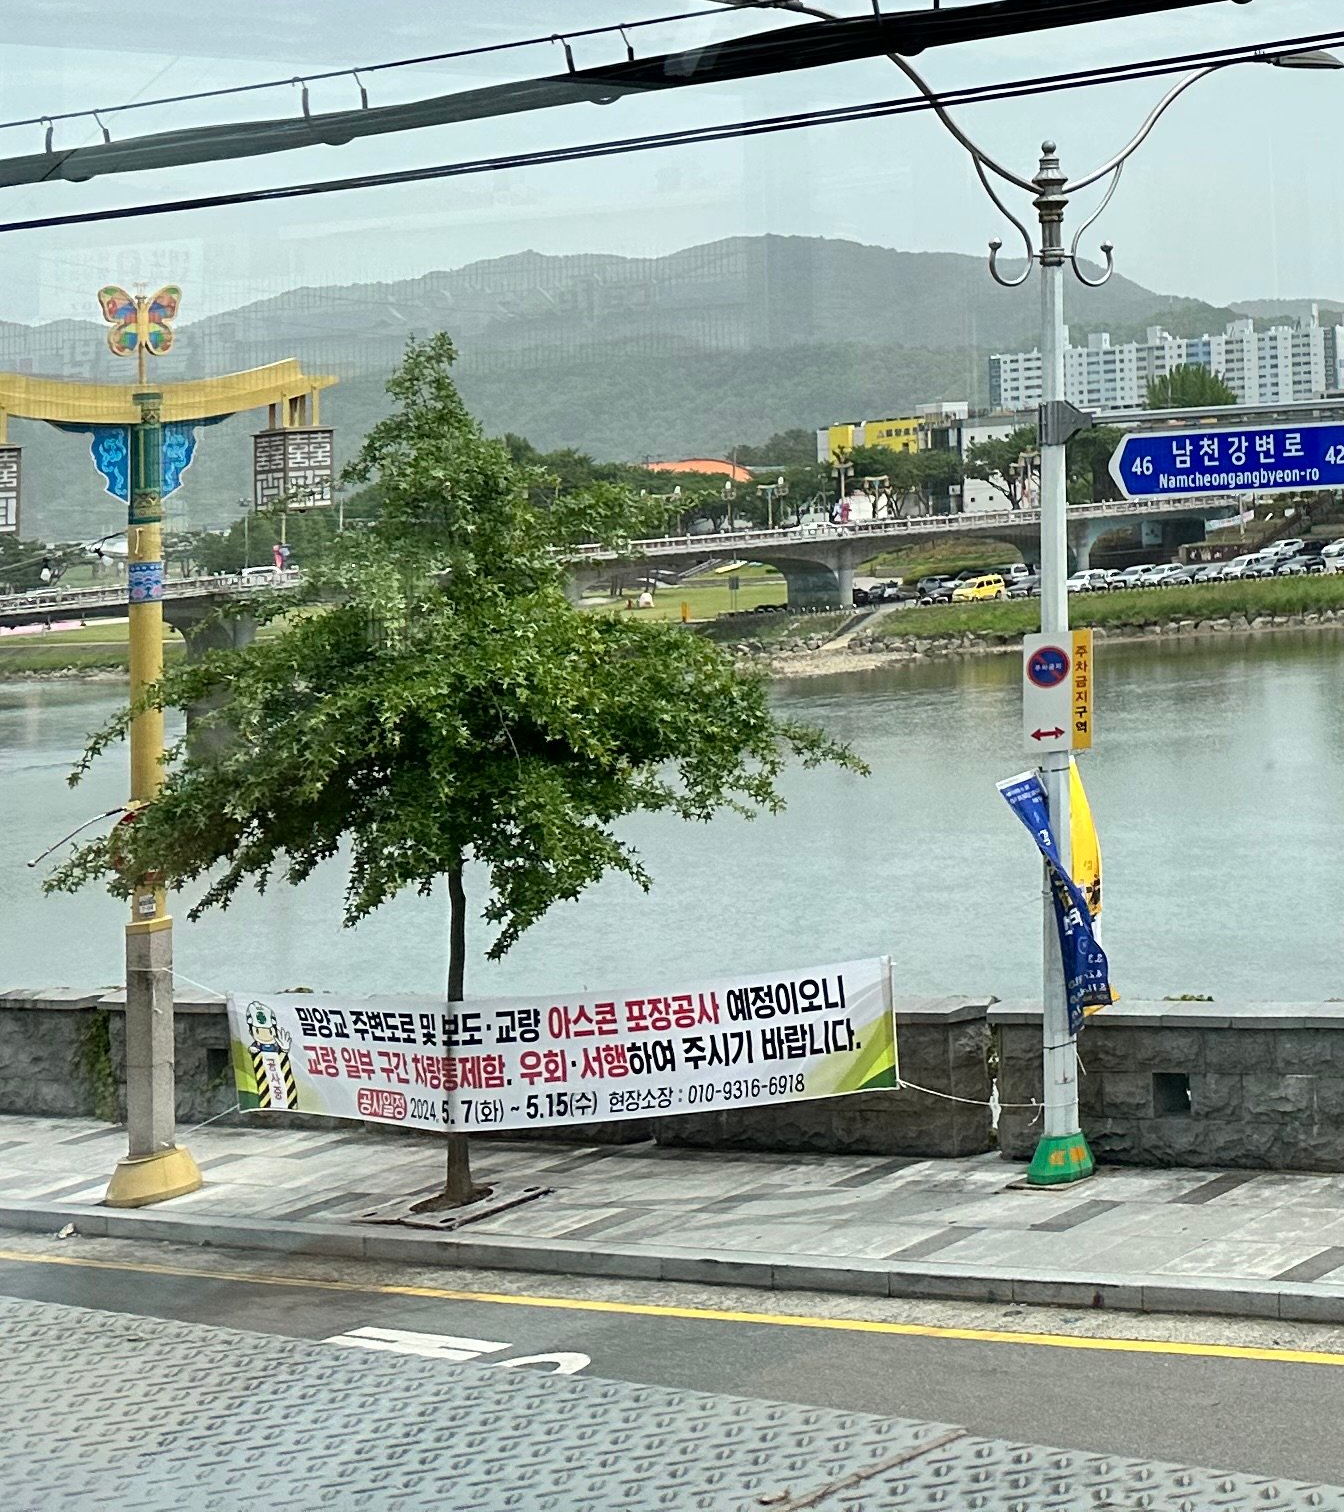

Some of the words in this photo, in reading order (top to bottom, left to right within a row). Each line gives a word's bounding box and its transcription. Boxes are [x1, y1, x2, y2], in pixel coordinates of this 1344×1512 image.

[1131, 456, 1153, 476] 46
[1172, 432, 1305, 469] 남천강변로
[1159, 467, 1320, 489] Namcheongangbyeon-ro
[1075, 645, 1088, 733] 주차금지구역
[295, 1007, 349, 1039] 밀양교
[350, 1011, 417, 1045] 주변도로
[419, 1014, 437, 1047] 및
[548, 1002, 619, 1040] 아스콘
[625, 991, 720, 1033] 포장공사
[727, 975, 846, 1021] 예정이오니
[303, 1045, 339, 1078] 교량
[341, 1046, 376, 1080] 일부
[377, 1050, 410, 1085] 구간
[412, 1052, 513, 1092] 차량통제함.
[682, 1029, 754, 1070] 주시기
[761, 1018, 862, 1061] 바랍니다.
[266, 1057, 283, 1101] 공사중
[359, 1090, 406, 1120] 공사일정
[526, 1090, 598, 1119] 5.15(수)
[688, 1073, 805, 1105] 010-9316-6918
